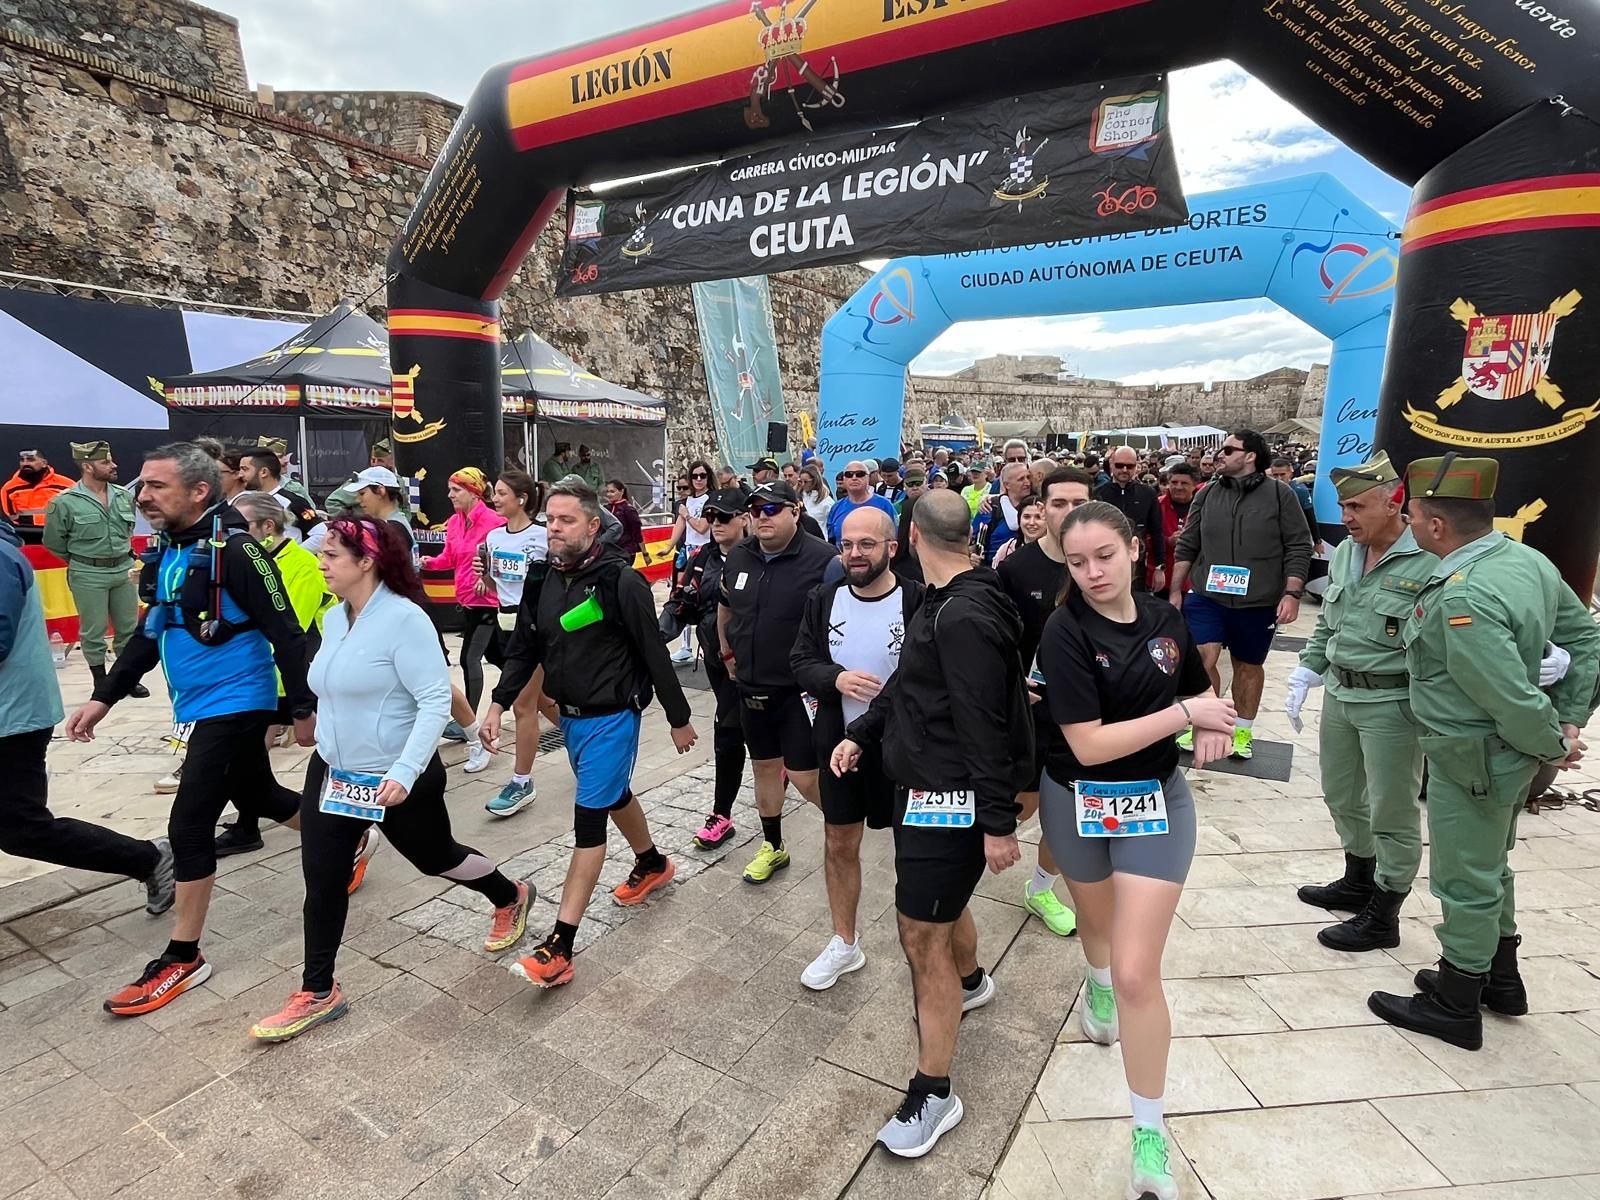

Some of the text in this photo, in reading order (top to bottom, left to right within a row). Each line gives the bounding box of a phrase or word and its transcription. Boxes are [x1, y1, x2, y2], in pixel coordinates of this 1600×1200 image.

[1400, 14, 1431, 33] que
[1430, 29, 1458, 52] una
[1457, 47, 1485, 70] vez.
[1452, 13, 1497, 43] mayor
[1494, 38, 1537, 73] honor.
[1263, 0, 1437, 128] Lo más horrible es vivir siendo
[1304, 4, 1327, 24] tan
[1326, 16, 1376, 57] horrible
[1372, 54, 1402, 78] como
[1394, 75, 1444, 109] parece.
[1305, 59, 1323, 75] un
[1368, 20, 1390, 37] sin
[1388, 32, 1422, 59] dolor
[1410, 56, 1433, 71] y
[1431, 64, 1456, 77] el
[1444, 73, 1482, 101] morir
[570, 47, 673, 104] LEGIÓN
[1104, 130, 1137, 142] Shop
[730, 141, 896, 182] CARRERA CÍVICO-MILITAR
[754, 188, 790, 216] DE
[796, 181, 831, 208] LA
[841, 150, 989, 201] LEGIÓN"
[750, 214, 855, 257] CEUTA
[960, 245, 1243, 289] CIUDAD AUTÓNOMA DE CEUTA
[174, 384, 286, 406] CLUB DEPORTIVO
[305, 384, 380, 408] TERCIO
[537, 399, 578, 417] TERCIO
[862, 417, 879, 427] es
[1413, 421, 1434, 434] TERCIO
[1451, 434, 1471, 442] JUAN
[1547, 431, 1558, 439] LA
[1558, 420, 1585, 435] LEGIÓN
[819, 437, 879, 462] Deporte
[502, 559, 519, 571] 936
[1222, 573, 1246, 585] 3706
[1109, 793, 1158, 816] 1241
[152, 966, 185, 998] TERREX
